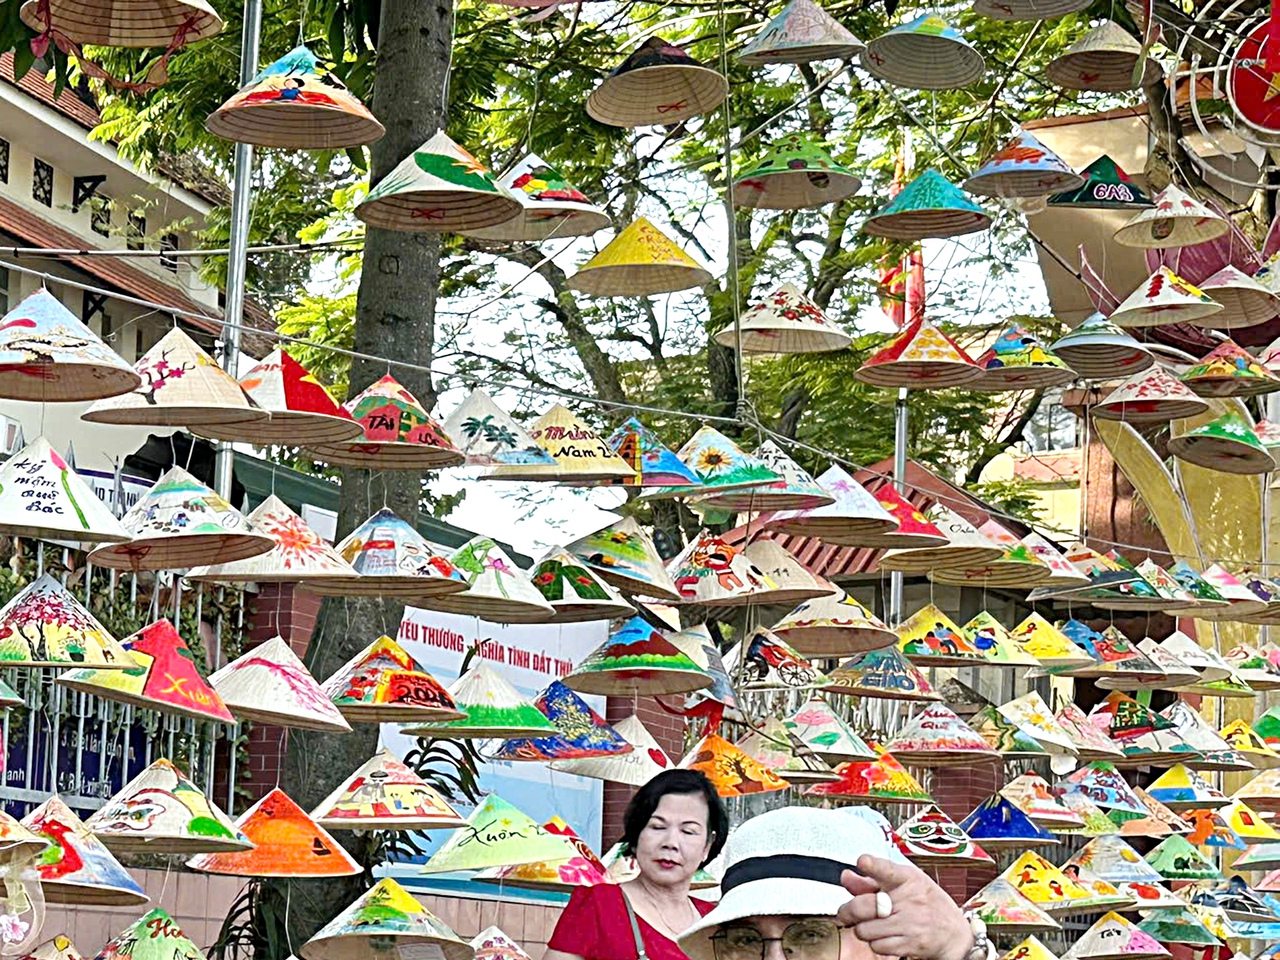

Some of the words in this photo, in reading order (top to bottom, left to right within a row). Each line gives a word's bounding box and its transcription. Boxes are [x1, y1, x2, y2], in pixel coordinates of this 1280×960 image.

[369, 415, 395, 431] TÀI
[400, 618, 418, 641] YÊU
[422, 625, 464, 653] THƯƠNG
[507, 645, 530, 669] TÌNH
